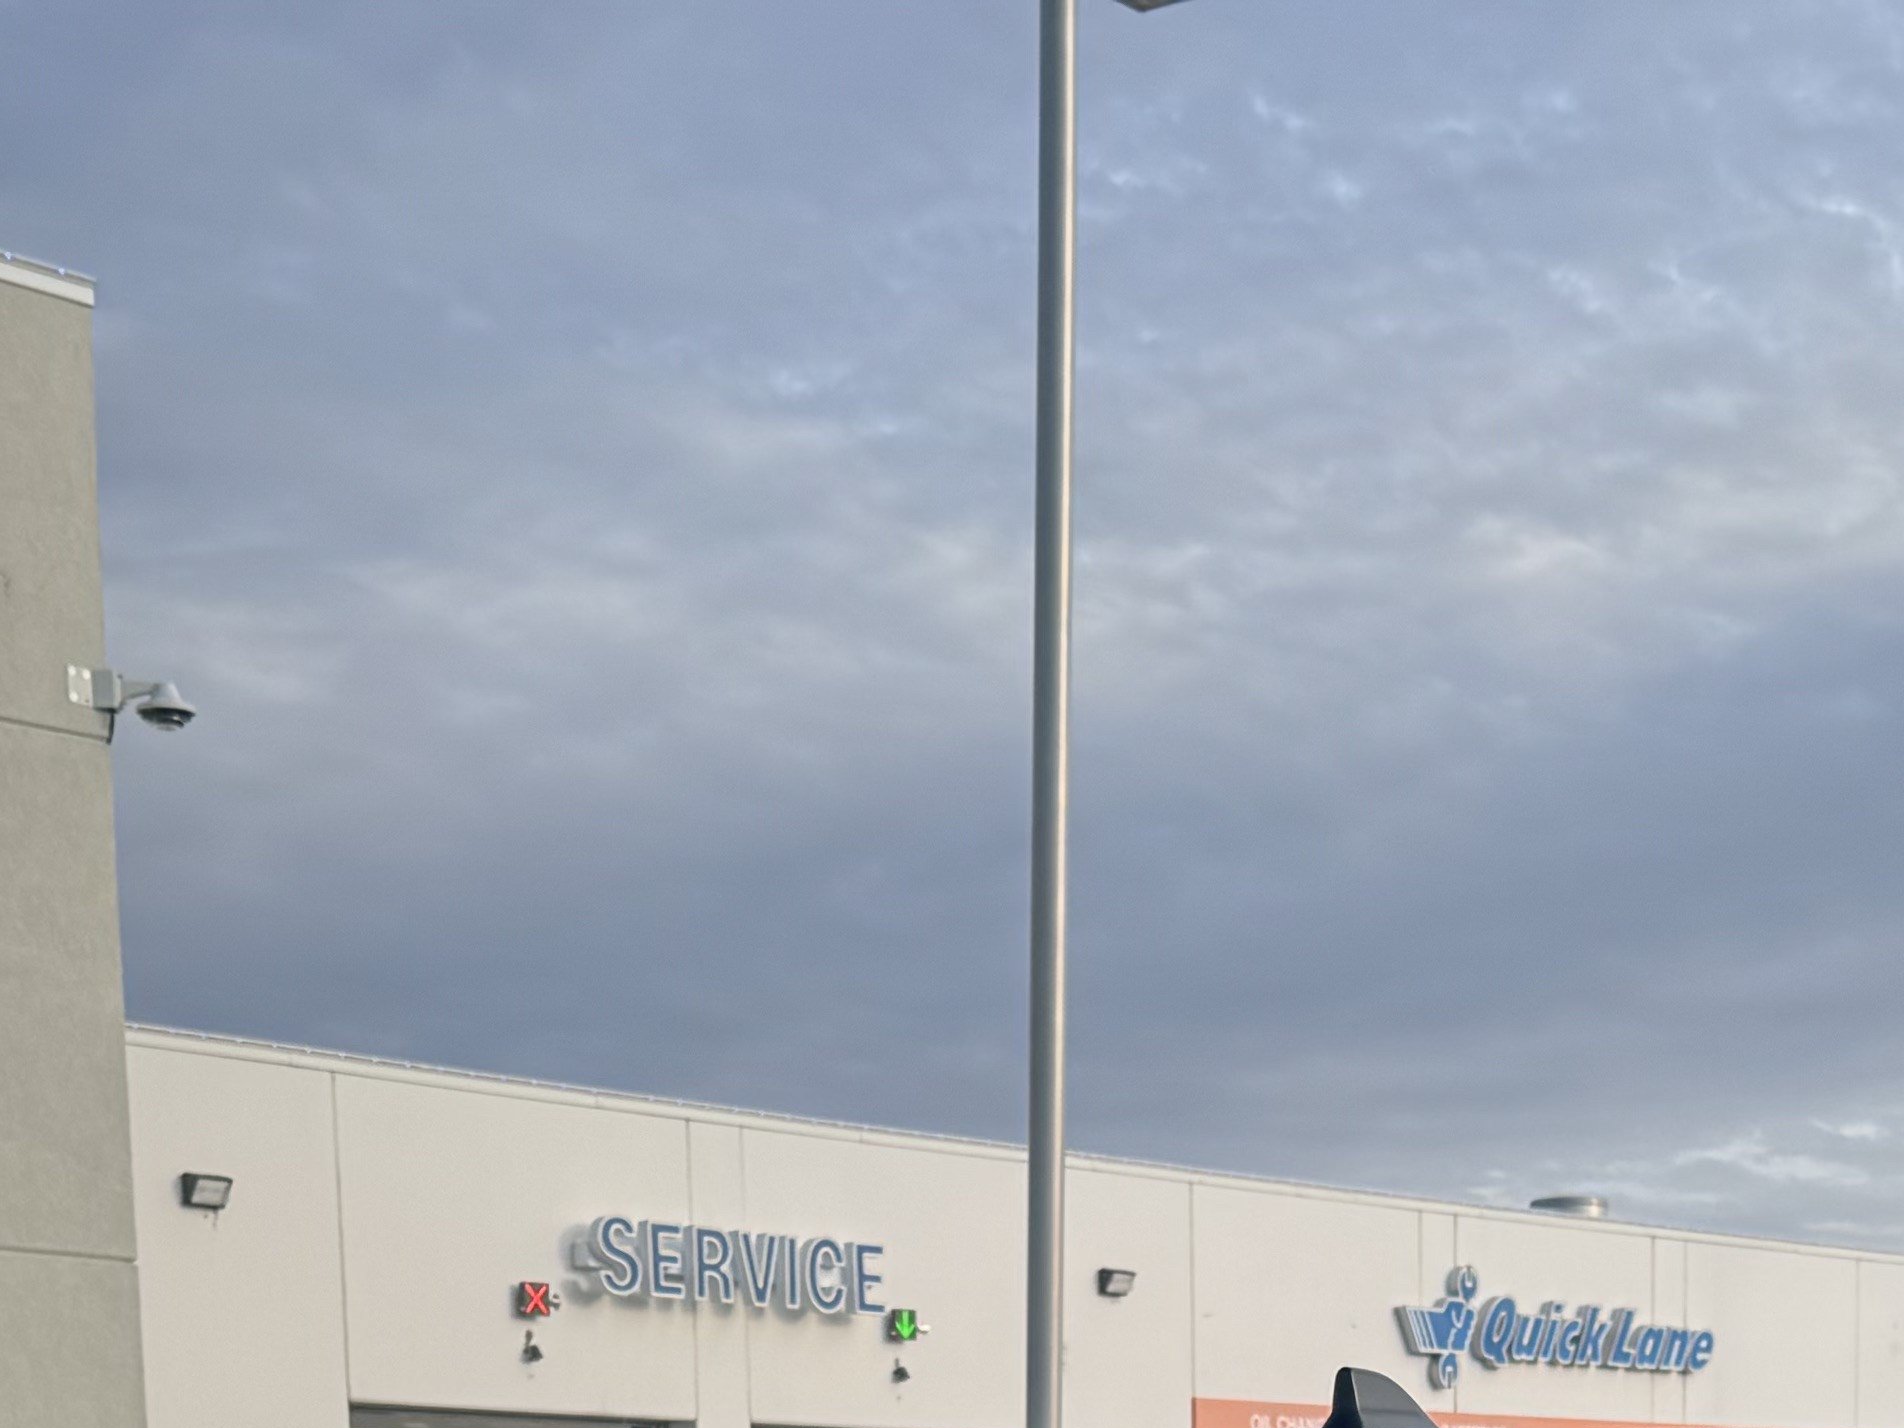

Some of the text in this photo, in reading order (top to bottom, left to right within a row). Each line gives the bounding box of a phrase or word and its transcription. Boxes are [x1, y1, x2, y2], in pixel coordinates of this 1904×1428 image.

[598, 1215, 888, 1315] SERVICE
[1476, 1295, 1715, 1373] Quick Lane
